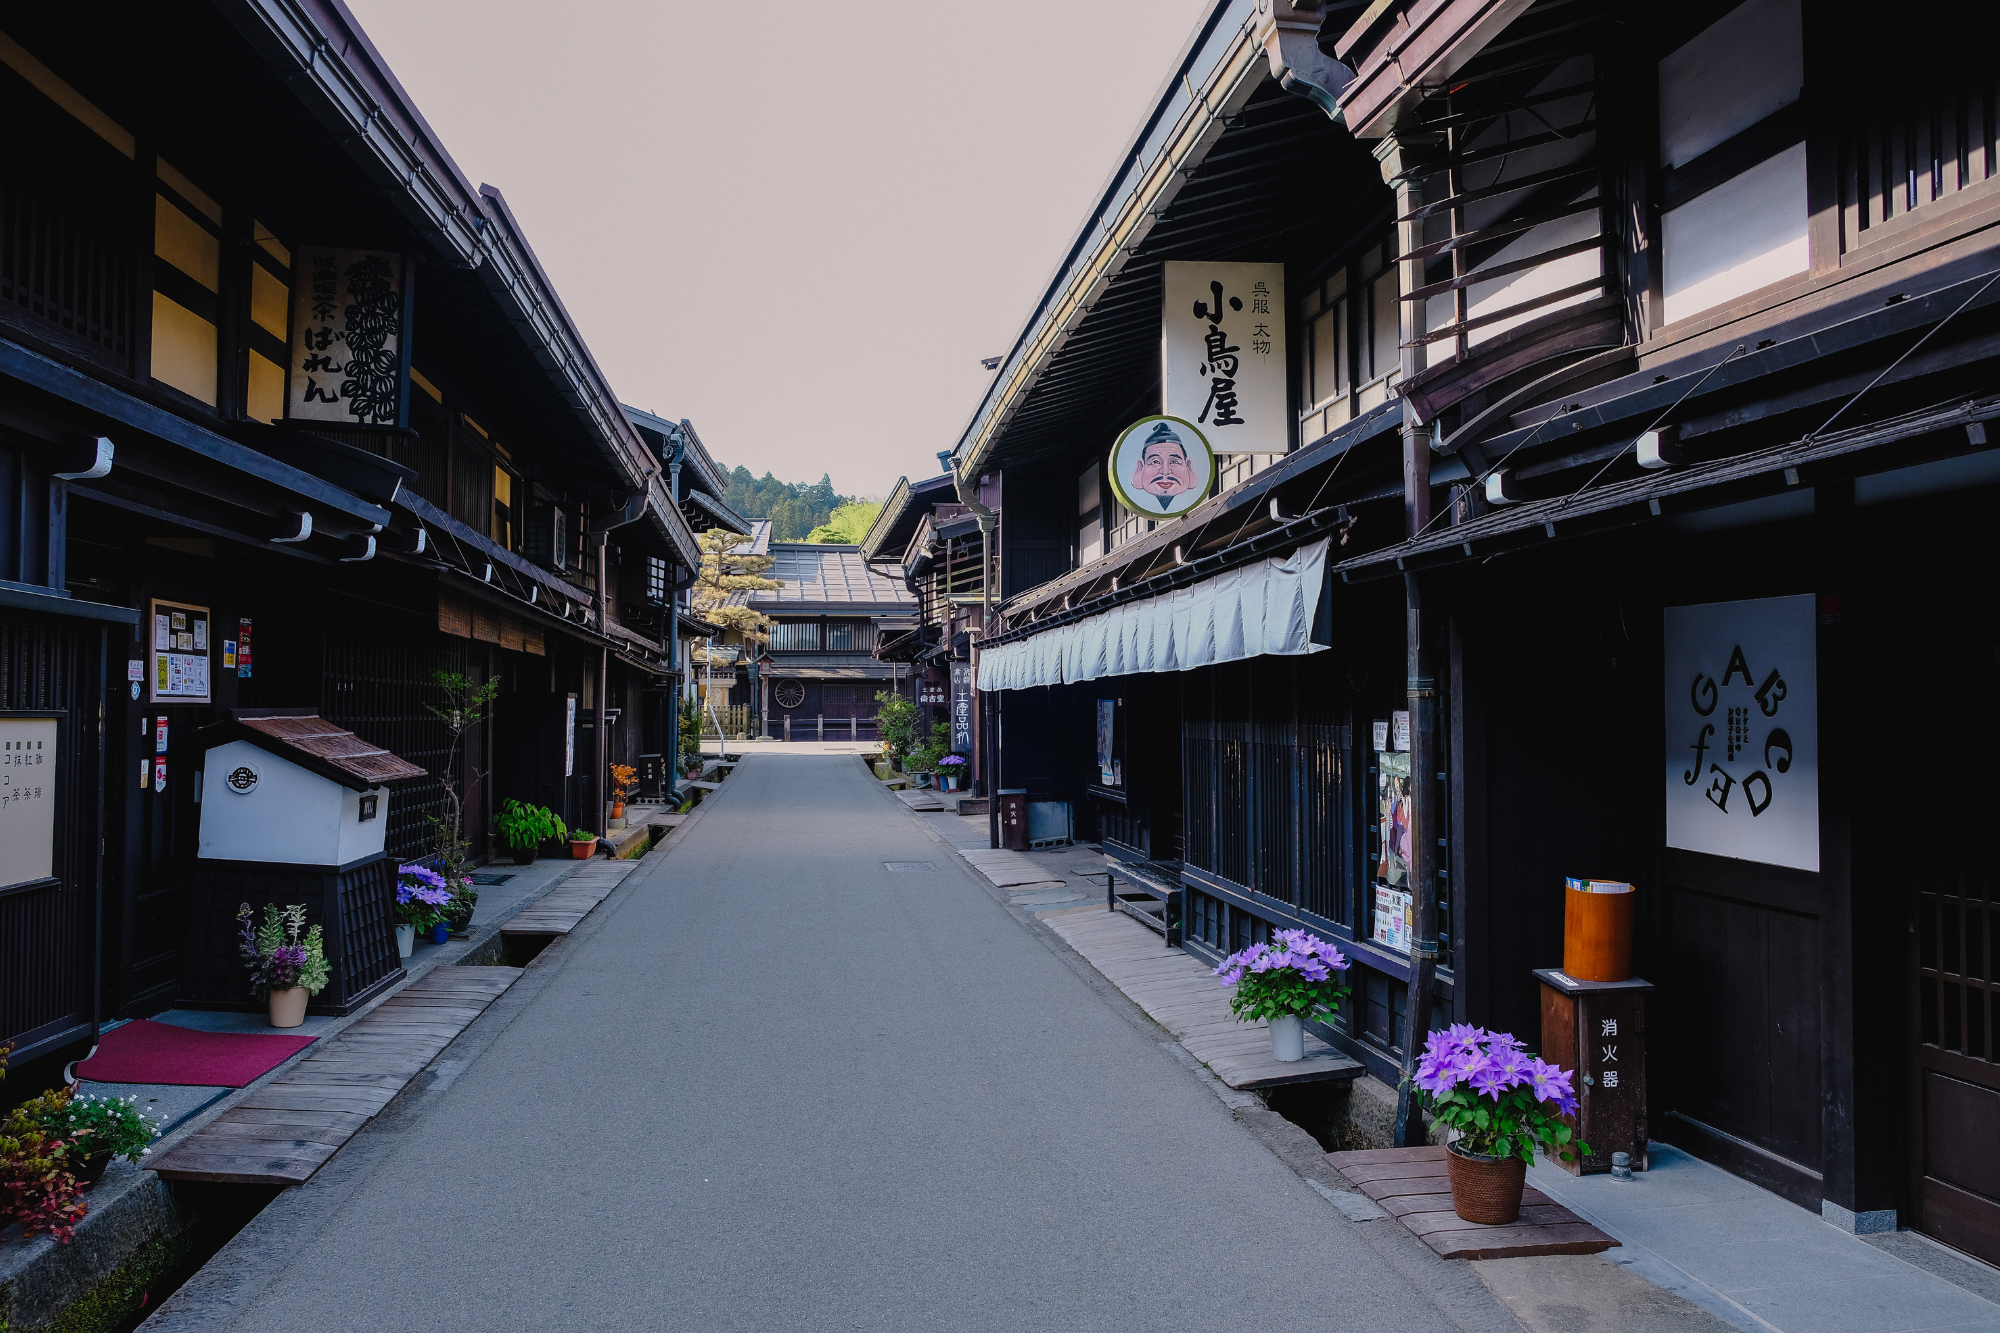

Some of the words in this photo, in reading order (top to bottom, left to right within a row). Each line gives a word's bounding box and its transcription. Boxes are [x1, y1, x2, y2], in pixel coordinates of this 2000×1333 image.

[1252, 282, 1270, 315] 呉服
[302, 327, 345, 403] ばれん
[1193, 280, 1245, 427] 小鳥屋
[1253, 322, 1271, 354] 太物
[24, 754, 32, 800] 紅茶
[1601, 1019, 1619, 1088] 消火器
